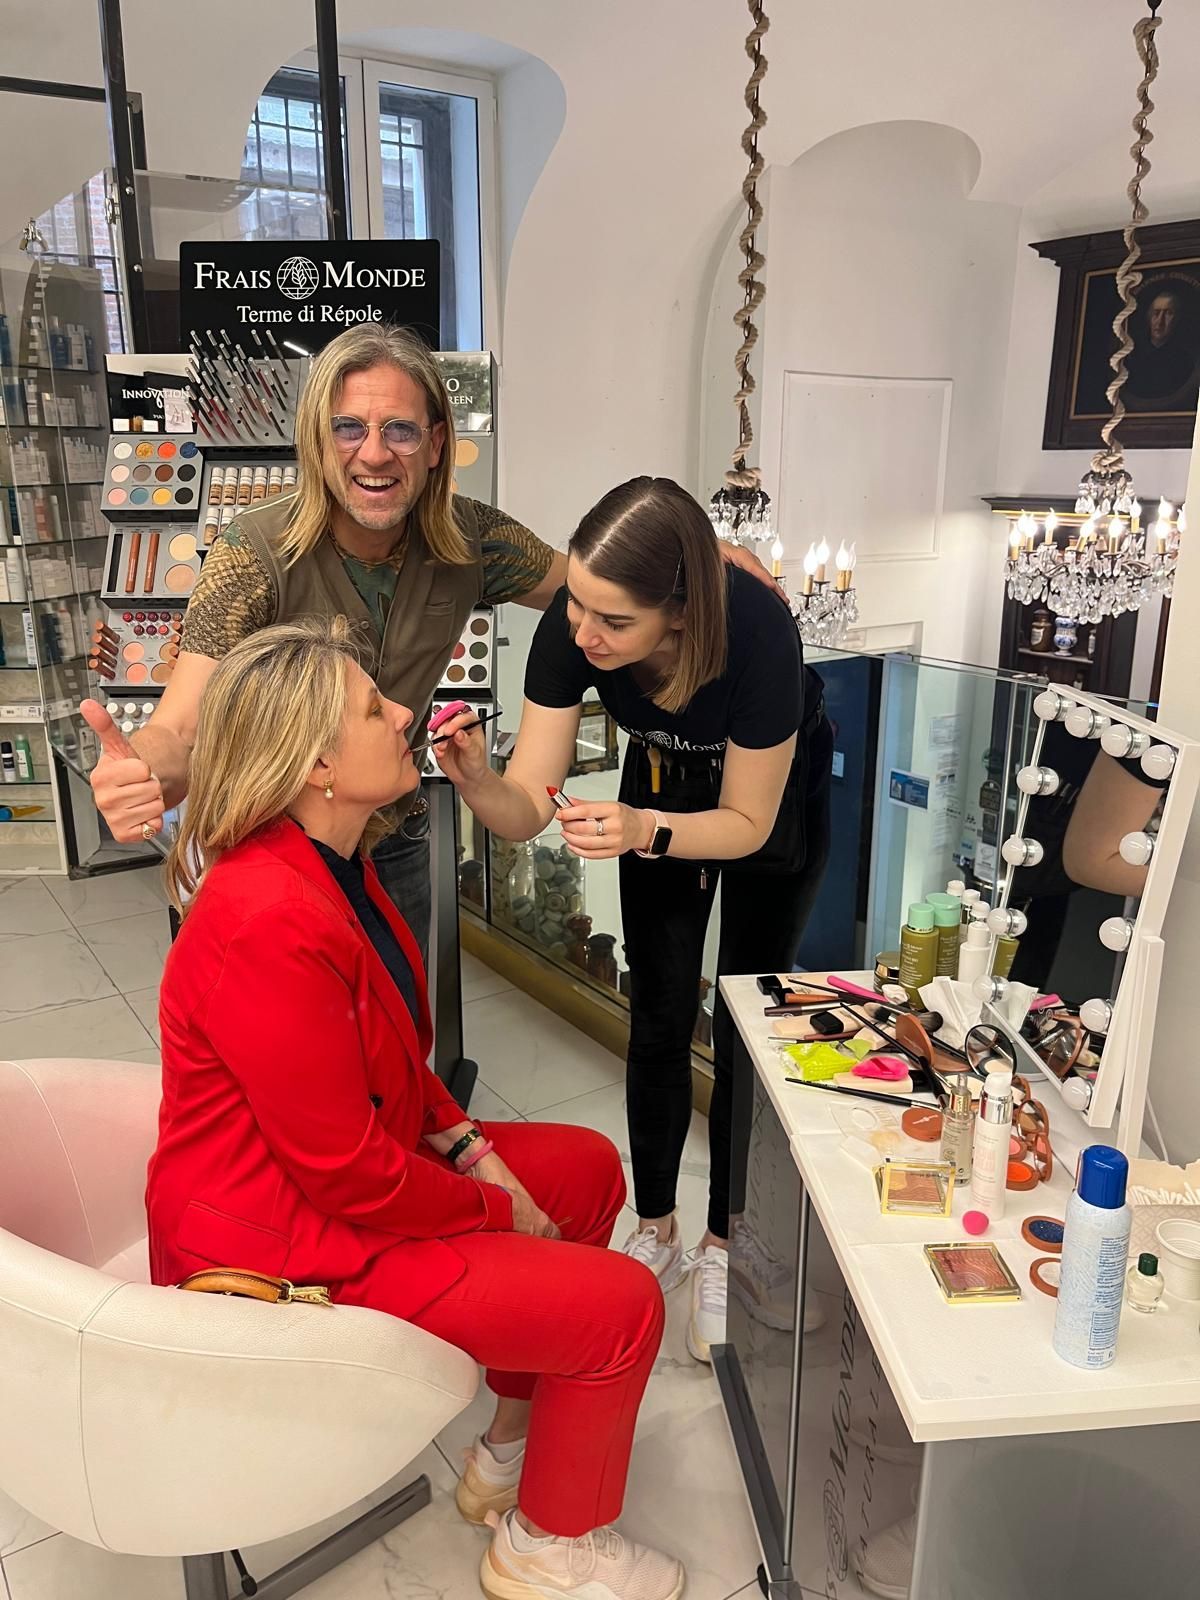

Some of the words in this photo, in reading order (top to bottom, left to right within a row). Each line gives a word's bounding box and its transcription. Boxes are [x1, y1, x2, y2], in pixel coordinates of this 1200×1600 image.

[194, 261, 271, 289] FRAIS
[322, 260, 426, 288] MONDE
[236, 304, 293, 323] Terme
[297, 304, 316, 322] di
[320, 303, 383, 327] Répole
[447, 394, 473, 405] REEN
[673, 733, 728, 752] MOND
